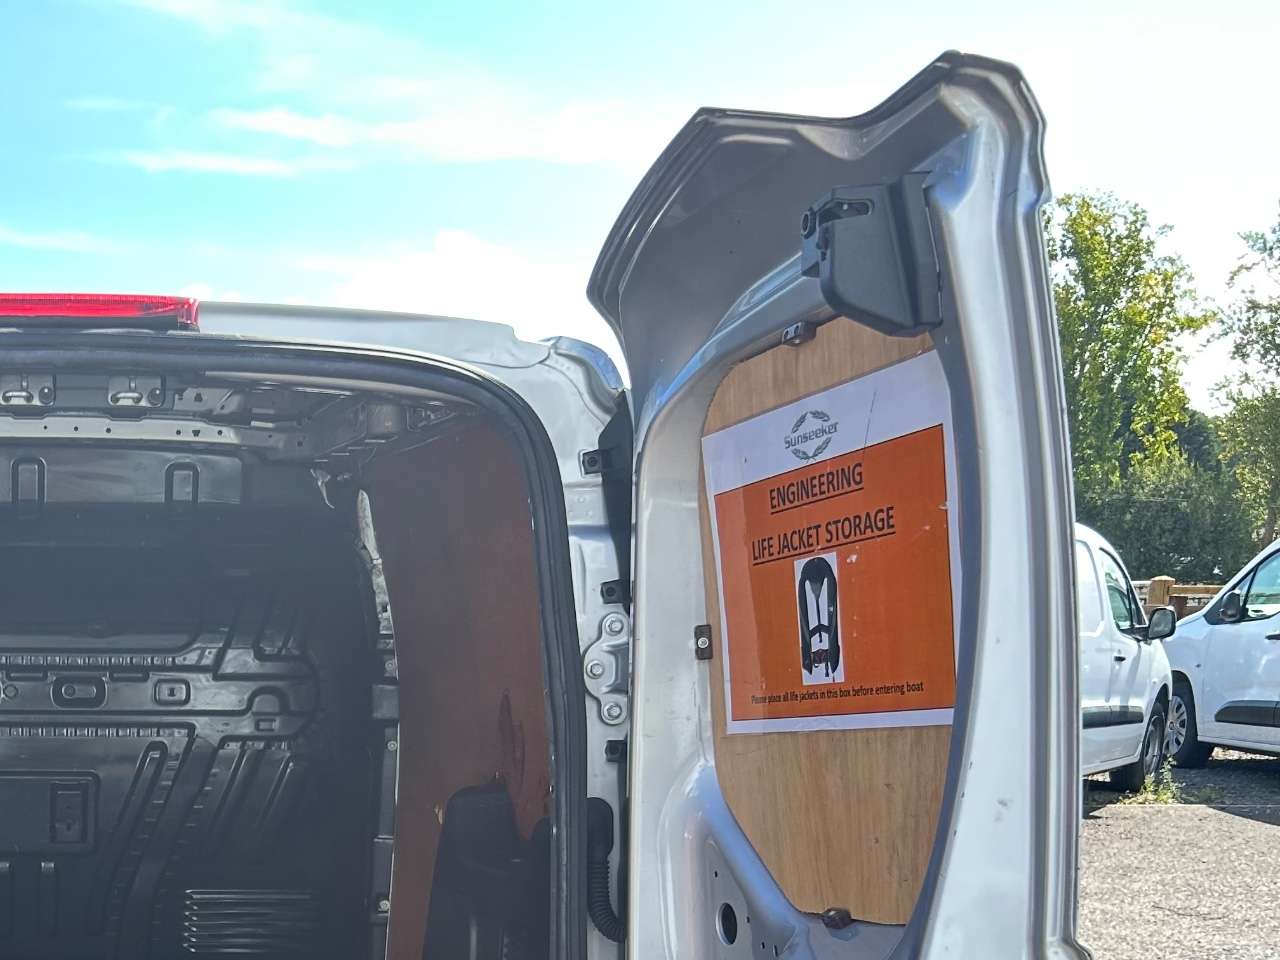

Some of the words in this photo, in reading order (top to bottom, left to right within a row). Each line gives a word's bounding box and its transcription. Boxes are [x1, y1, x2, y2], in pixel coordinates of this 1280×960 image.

[784, 421, 839, 450] Sunseeker
[769, 462, 864, 510] ENGINEERING
[752, 536, 774, 562] LIFE
[777, 524, 821, 556] JACKET
[825, 506, 896, 544] STORAGE
[799, 688, 819, 703] jackets
[826, 687, 839, 699] this
[839, 687, 851, 698] box
[851, 685, 874, 697] before
[874, 682, 905, 696] entering
[905, 681, 924, 693] boat
